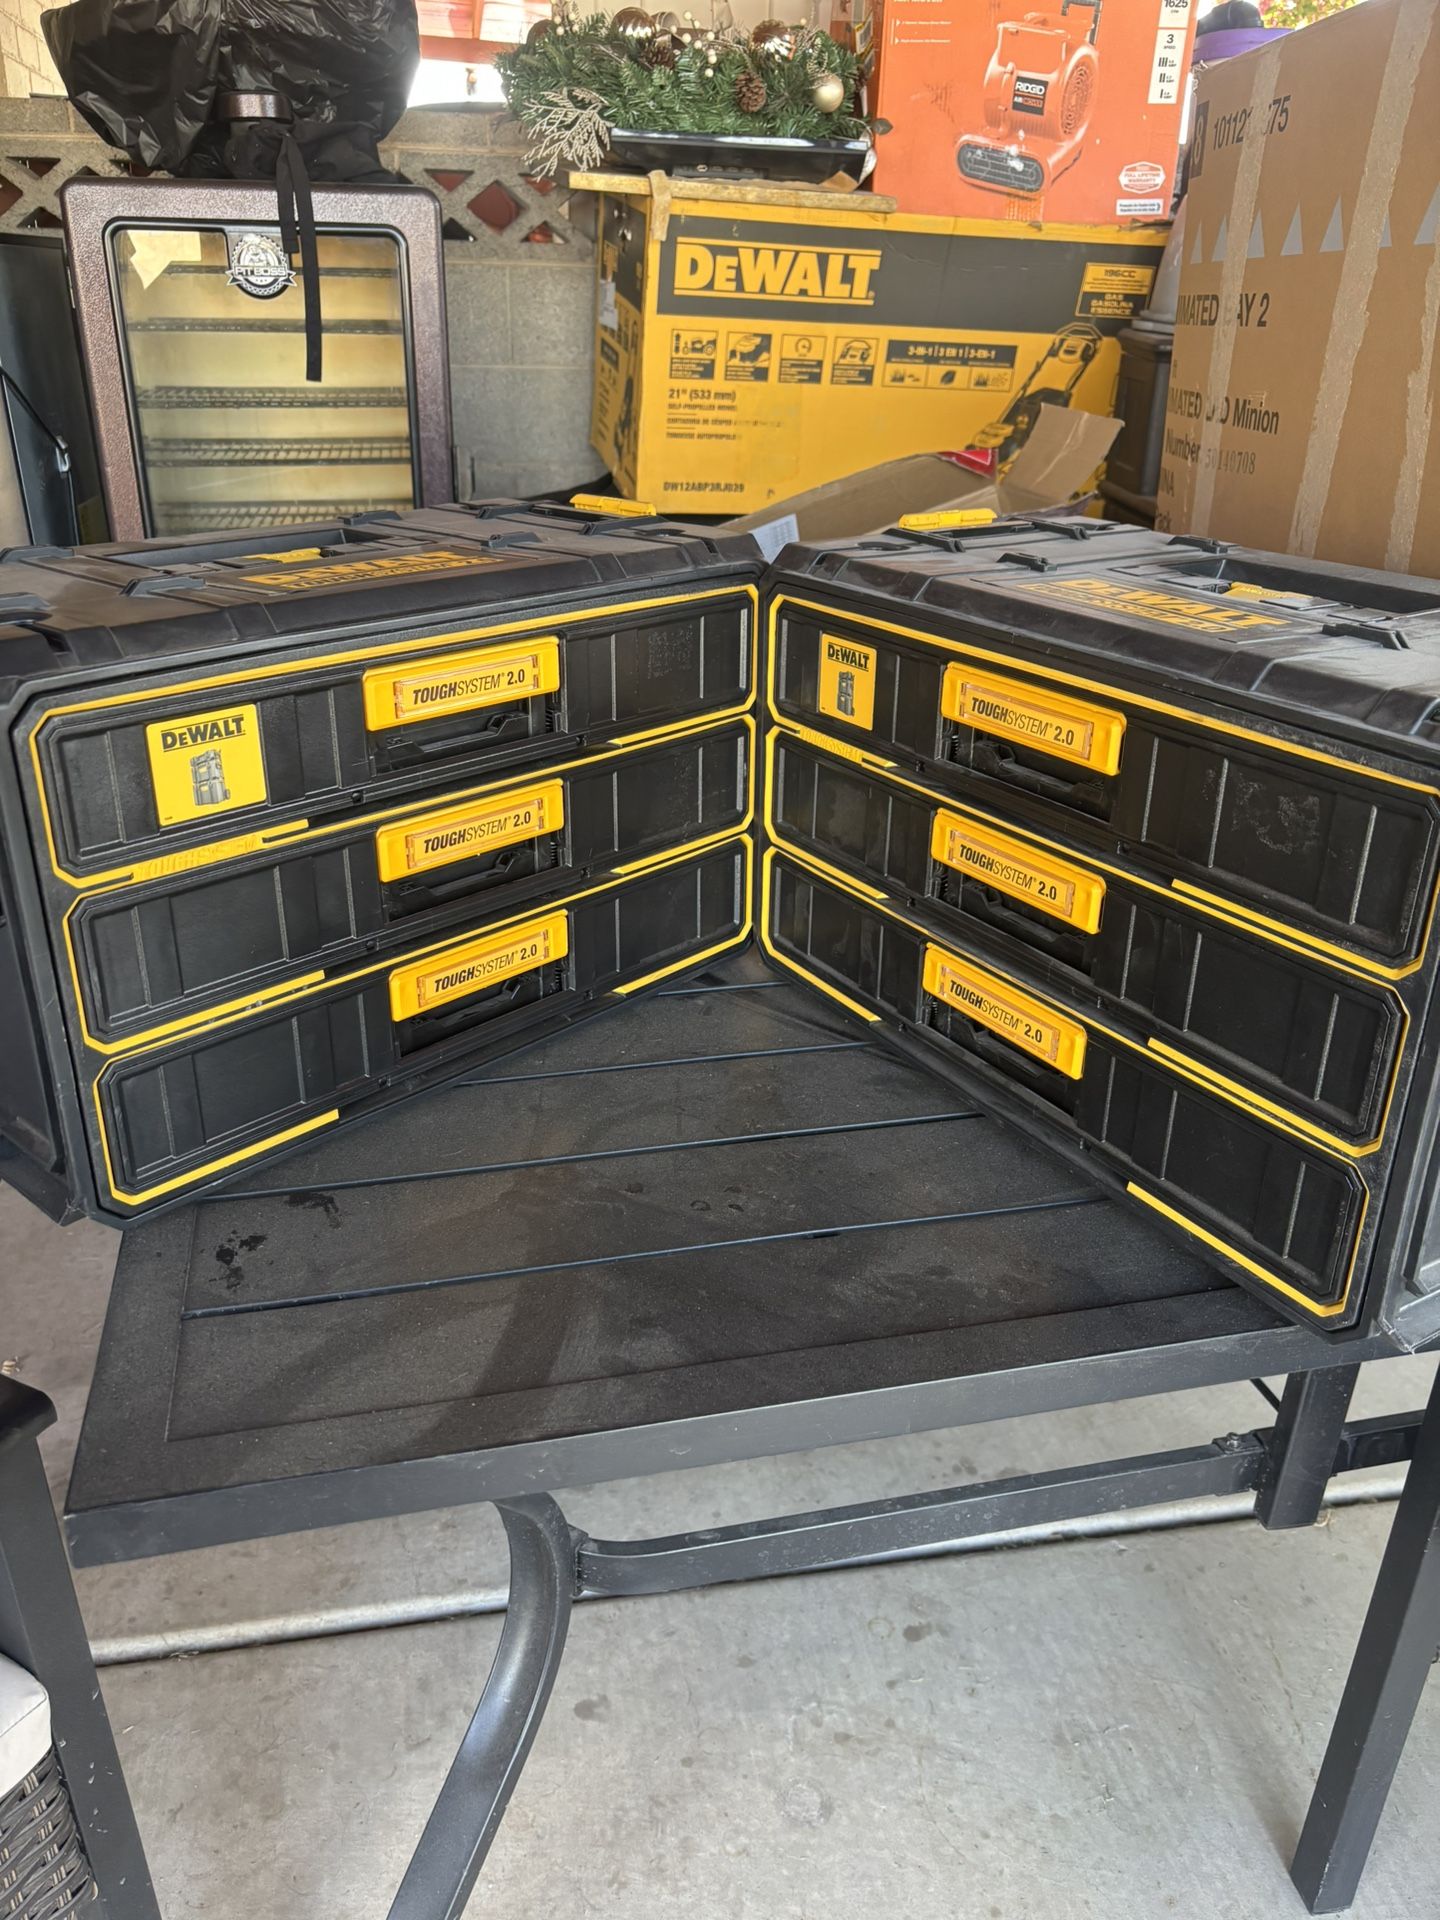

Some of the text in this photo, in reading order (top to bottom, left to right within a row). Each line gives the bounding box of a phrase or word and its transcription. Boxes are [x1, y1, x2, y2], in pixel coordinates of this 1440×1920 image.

[1166, 33, 1175, 44] 3
[1257, 292, 1270, 327] 2
[1232, 398, 1280, 435] Minion
[507, 668, 525, 685] 2.0
[1054, 725, 1074, 746] 2.0
[513, 811, 531, 828] 2.0
[1038, 881, 1057, 900] 2.0
[520, 944, 537, 961] 2.0
[1024, 1023, 1043, 1043] 2.0
